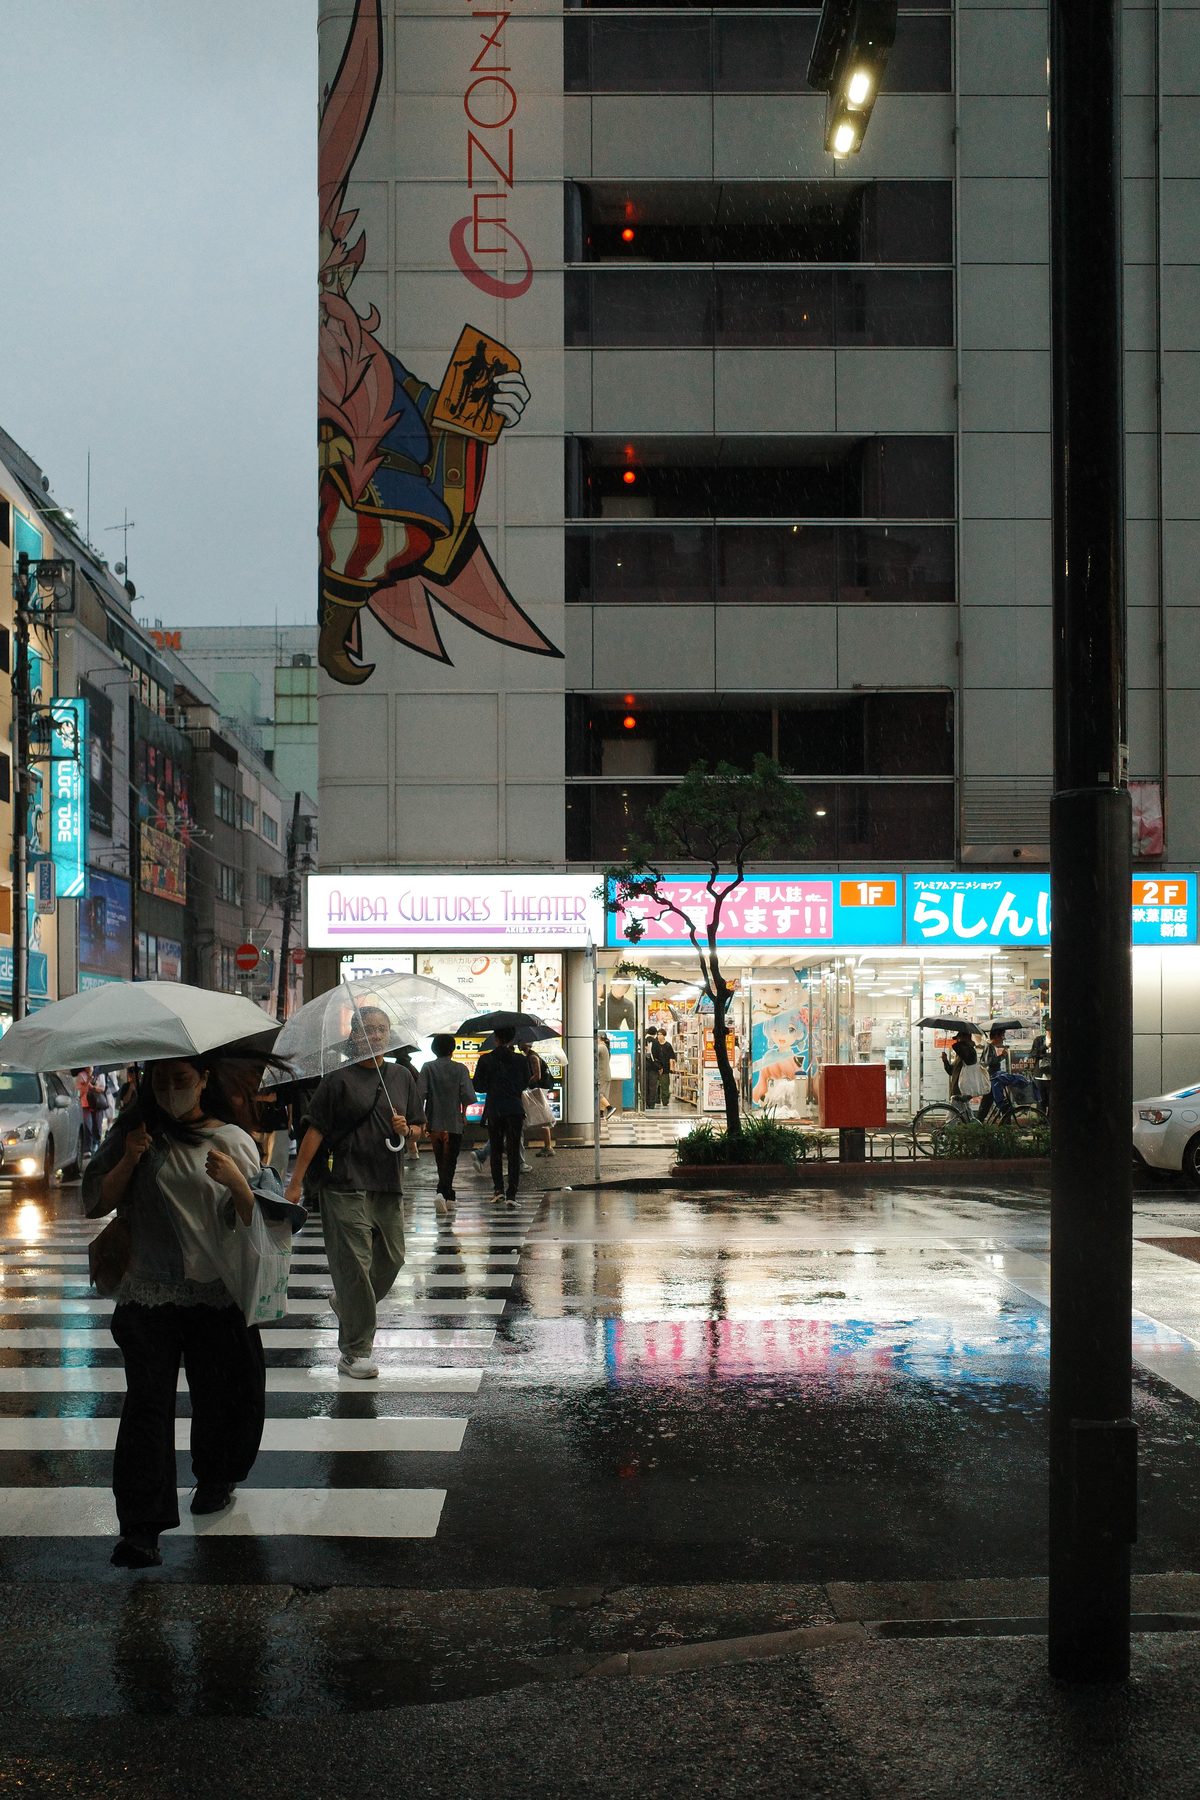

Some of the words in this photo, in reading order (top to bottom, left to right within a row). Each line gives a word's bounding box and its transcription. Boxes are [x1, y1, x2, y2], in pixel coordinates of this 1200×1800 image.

[754, 886, 803, 903] 同人誌
[856, 883, 884, 905] 1F
[1142, 882, 1179, 905] 2F
[327, 889, 388, 922] AKIBA
[398, 889, 491, 922] CULTURES
[500, 889, 587, 922] THEATER
[1132, 908, 1188, 923] 秋葉原店
[1160, 924, 1188, 938] 新館
[523, 955, 534, 963] 5F
